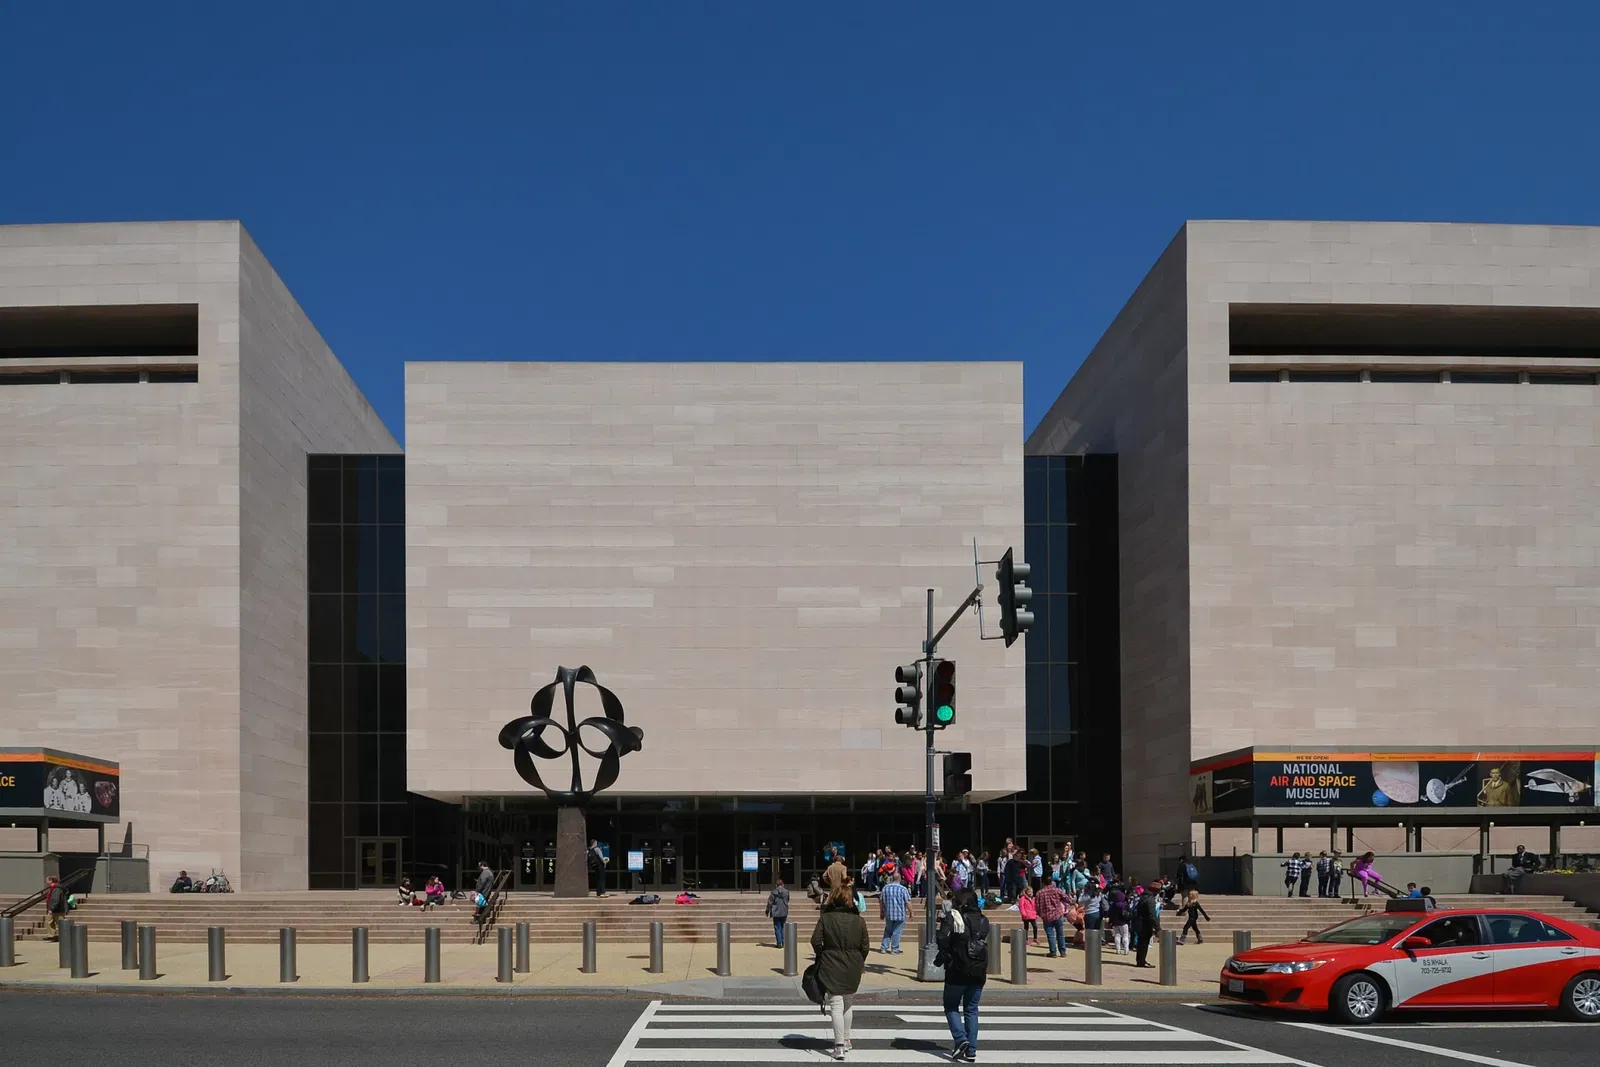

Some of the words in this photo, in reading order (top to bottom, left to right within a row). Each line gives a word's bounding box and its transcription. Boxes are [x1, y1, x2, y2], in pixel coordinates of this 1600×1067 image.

[1283, 763, 1343, 775] NATIONAL
[0, 776, 15, 787] CE
[1270, 776, 1289, 787] AIR
[1292, 776, 1316, 787] AND
[1318, 776, 1356, 787] SPACE
[1285, 788, 1340, 799] MUSEUM
